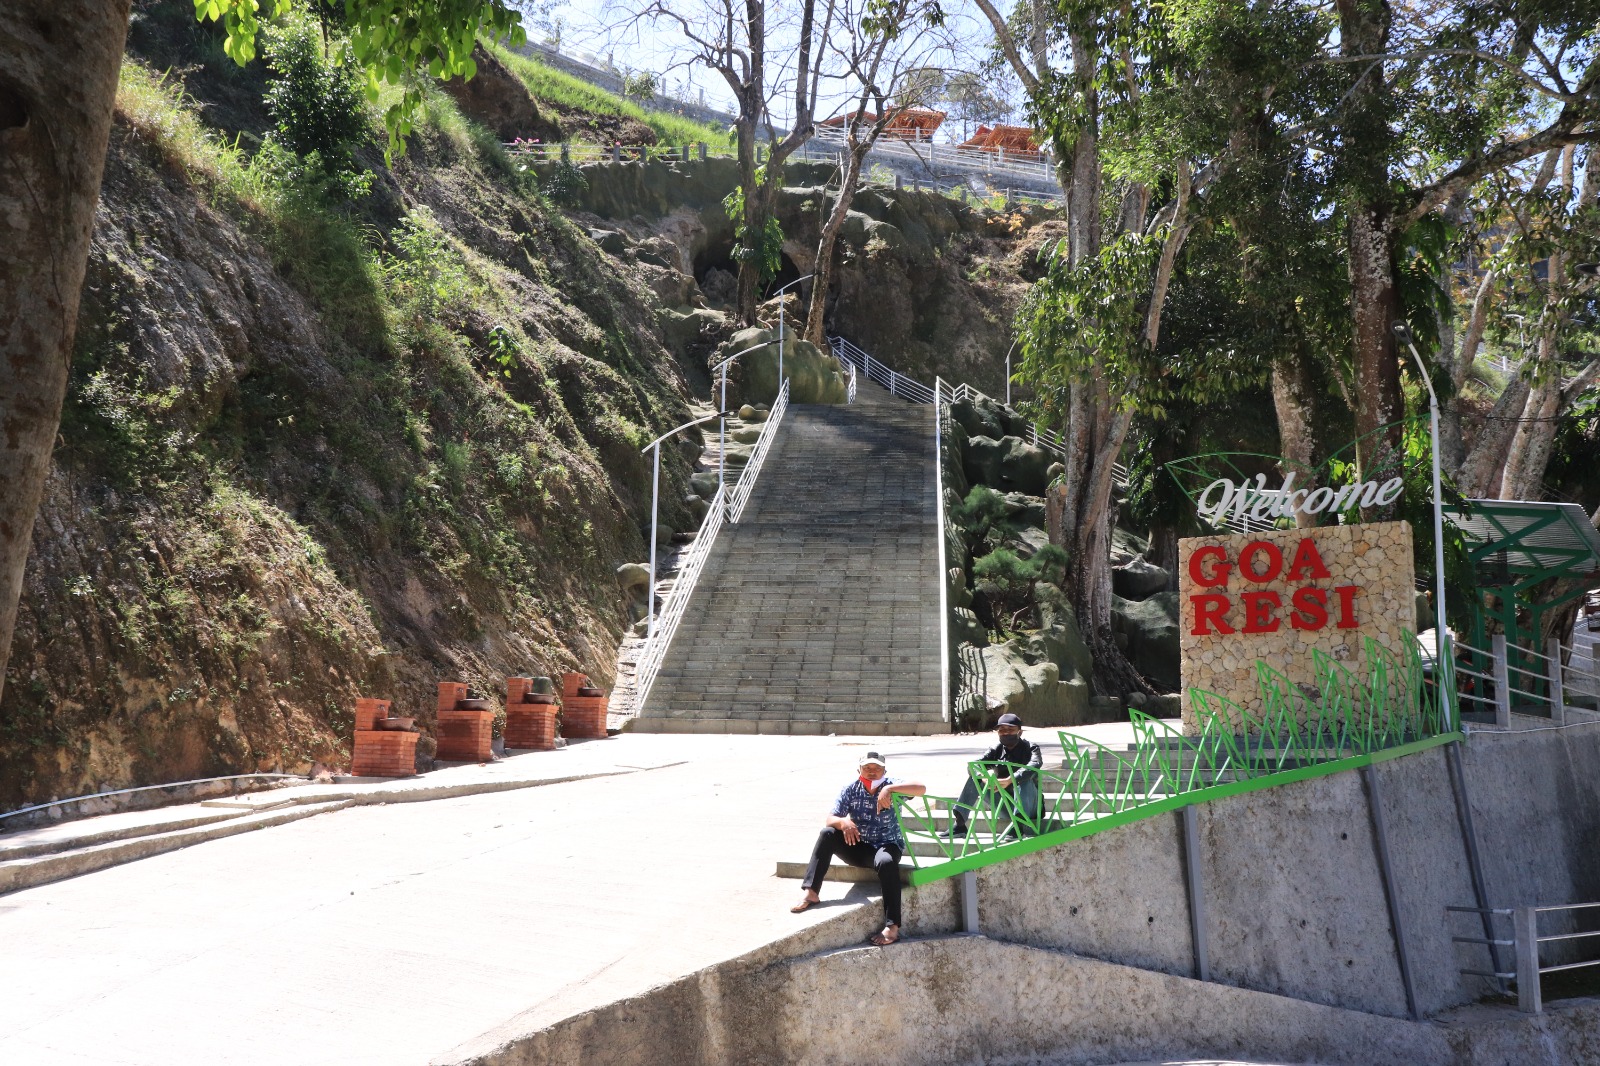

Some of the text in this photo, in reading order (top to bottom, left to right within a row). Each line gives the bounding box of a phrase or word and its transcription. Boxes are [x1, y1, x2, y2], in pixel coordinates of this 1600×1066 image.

[1198, 472, 1404, 527] Welcome
[1188, 537, 1331, 588] GOA
[1189, 585, 1359, 635] RESI
